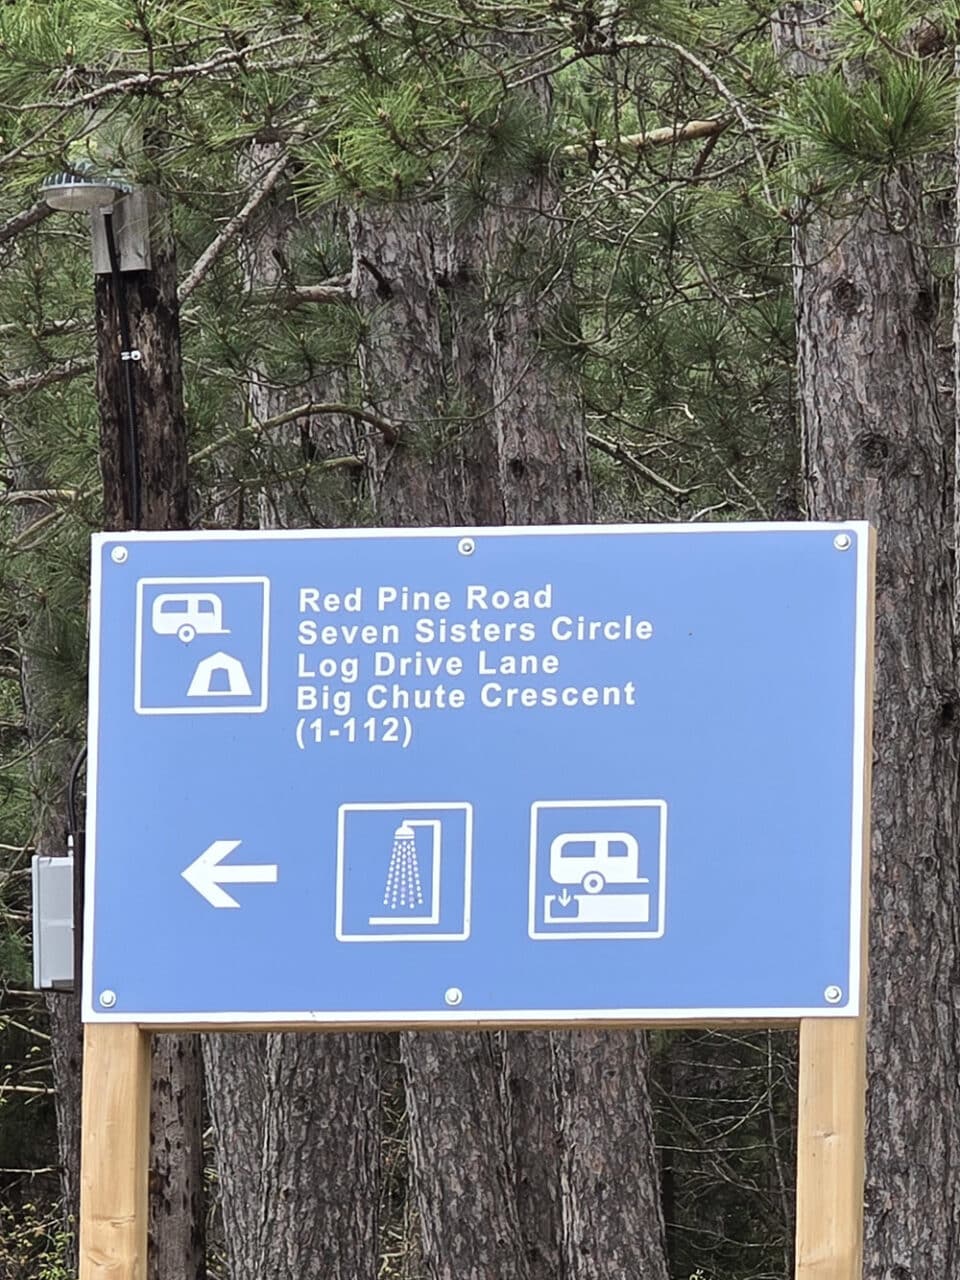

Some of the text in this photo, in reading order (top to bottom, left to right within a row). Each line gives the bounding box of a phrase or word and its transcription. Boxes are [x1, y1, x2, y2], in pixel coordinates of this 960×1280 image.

[300, 584, 551, 612] Red Pine Road
[298, 615, 652, 644] Seven Sisters Circle
[298, 650, 559, 683] Log Drive Lane
[297, 682, 635, 715] Big Chute Crescent
[296, 716, 412, 749] (1-112)
